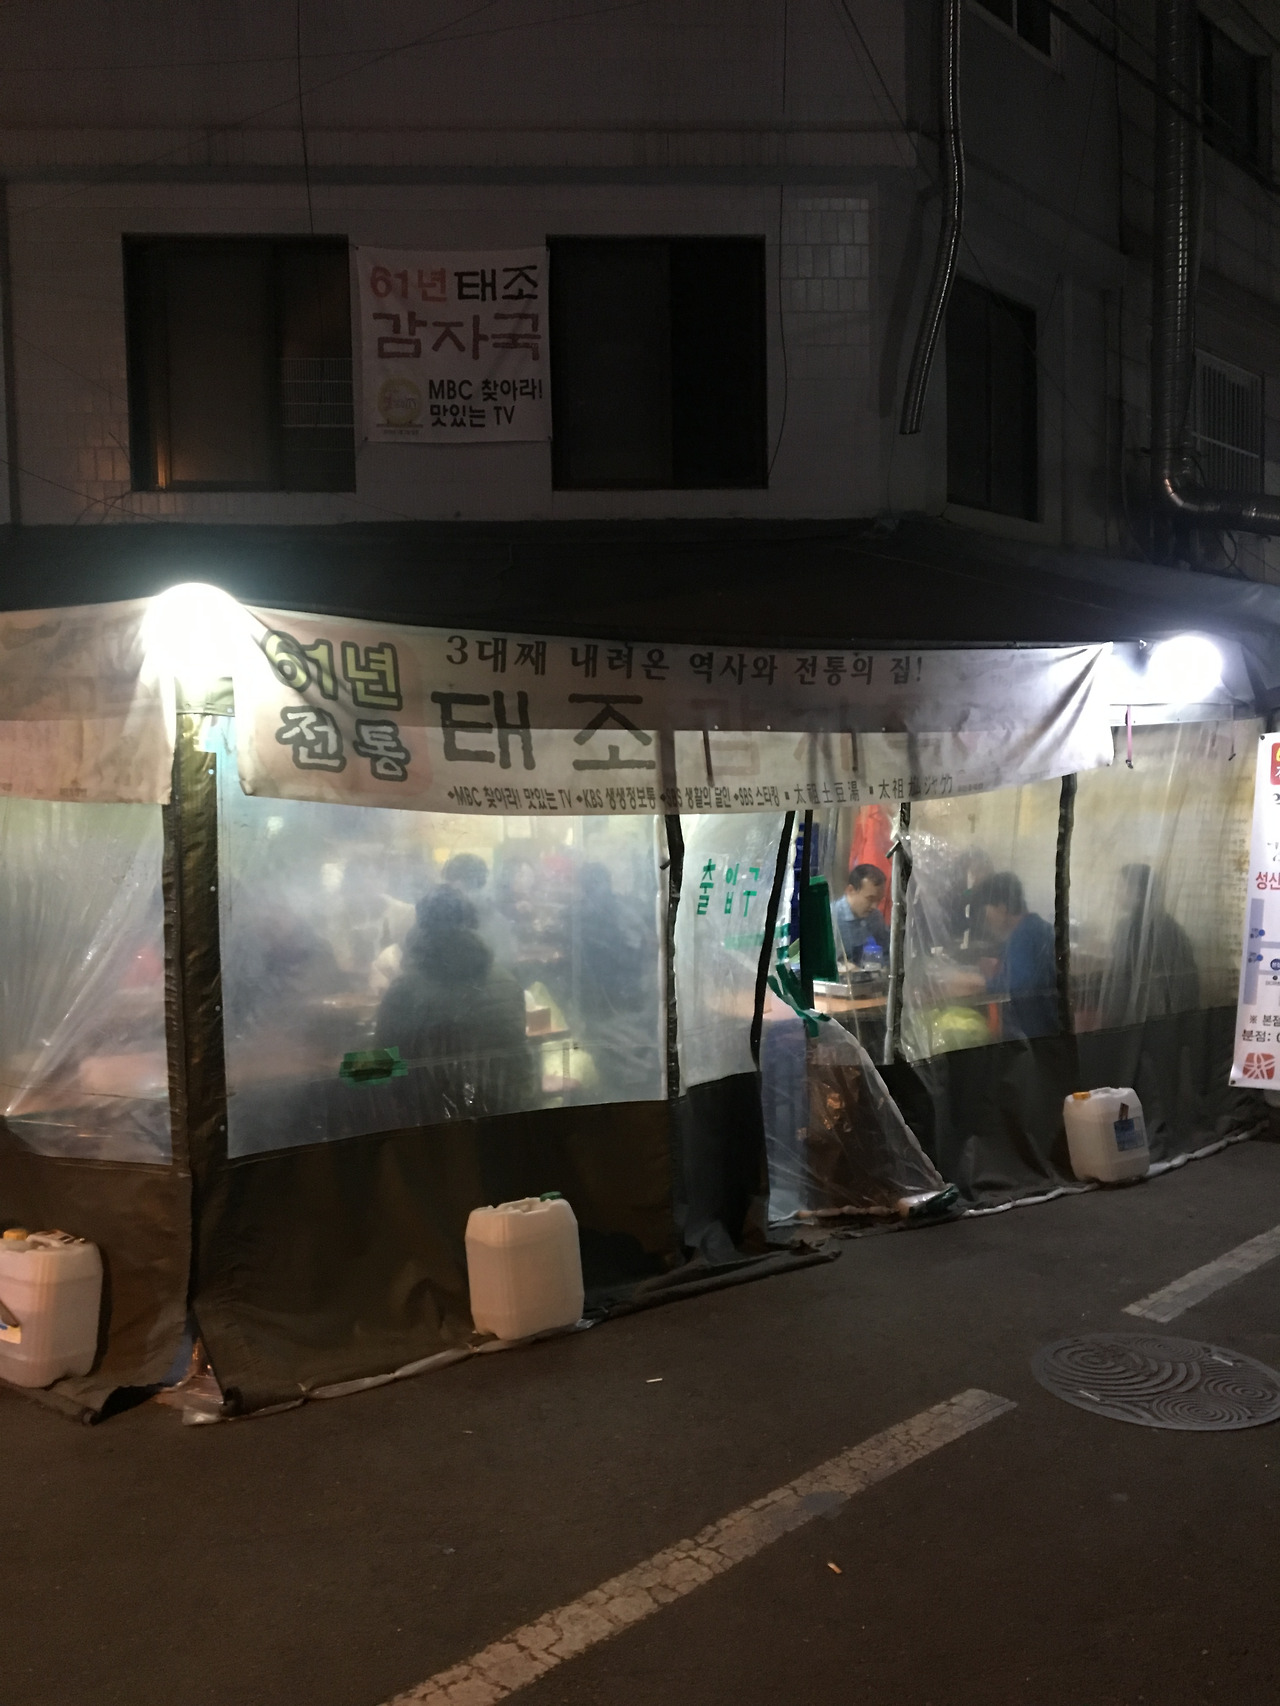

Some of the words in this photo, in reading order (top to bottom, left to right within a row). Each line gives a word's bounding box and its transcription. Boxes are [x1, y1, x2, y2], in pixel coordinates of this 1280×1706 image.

[370, 266, 447, 302] 61년
[454, 265, 538, 301] 태조
[373, 311, 541, 361] 감자국
[429, 379, 473, 400] MBC
[482, 378, 543, 401] 찾아라!
[430, 404, 486, 428] 맛있는
[494, 405, 515, 426] TV
[261, 630, 403, 711] 61년
[446, 635, 547, 676] 3대째
[571, 643, 670, 680] 내려온
[689, 651, 778, 685] 역사와
[795, 655, 874, 686] 전통의
[890, 655, 923, 685] 집!
[275, 705, 411, 782] 전통
[454, 786, 480, 807] MBC
[483, 786, 522, 809] 찾아라!
[523, 788, 559, 810] 맛있는
[559, 789, 574, 809] TV
[582, 788, 604, 809] KBS
[685, 786, 713, 810] 생활의
[714, 786, 732, 809] 달인
[739, 786, 754, 807] SBS
[755, 786, 780, 808] 스타킹
